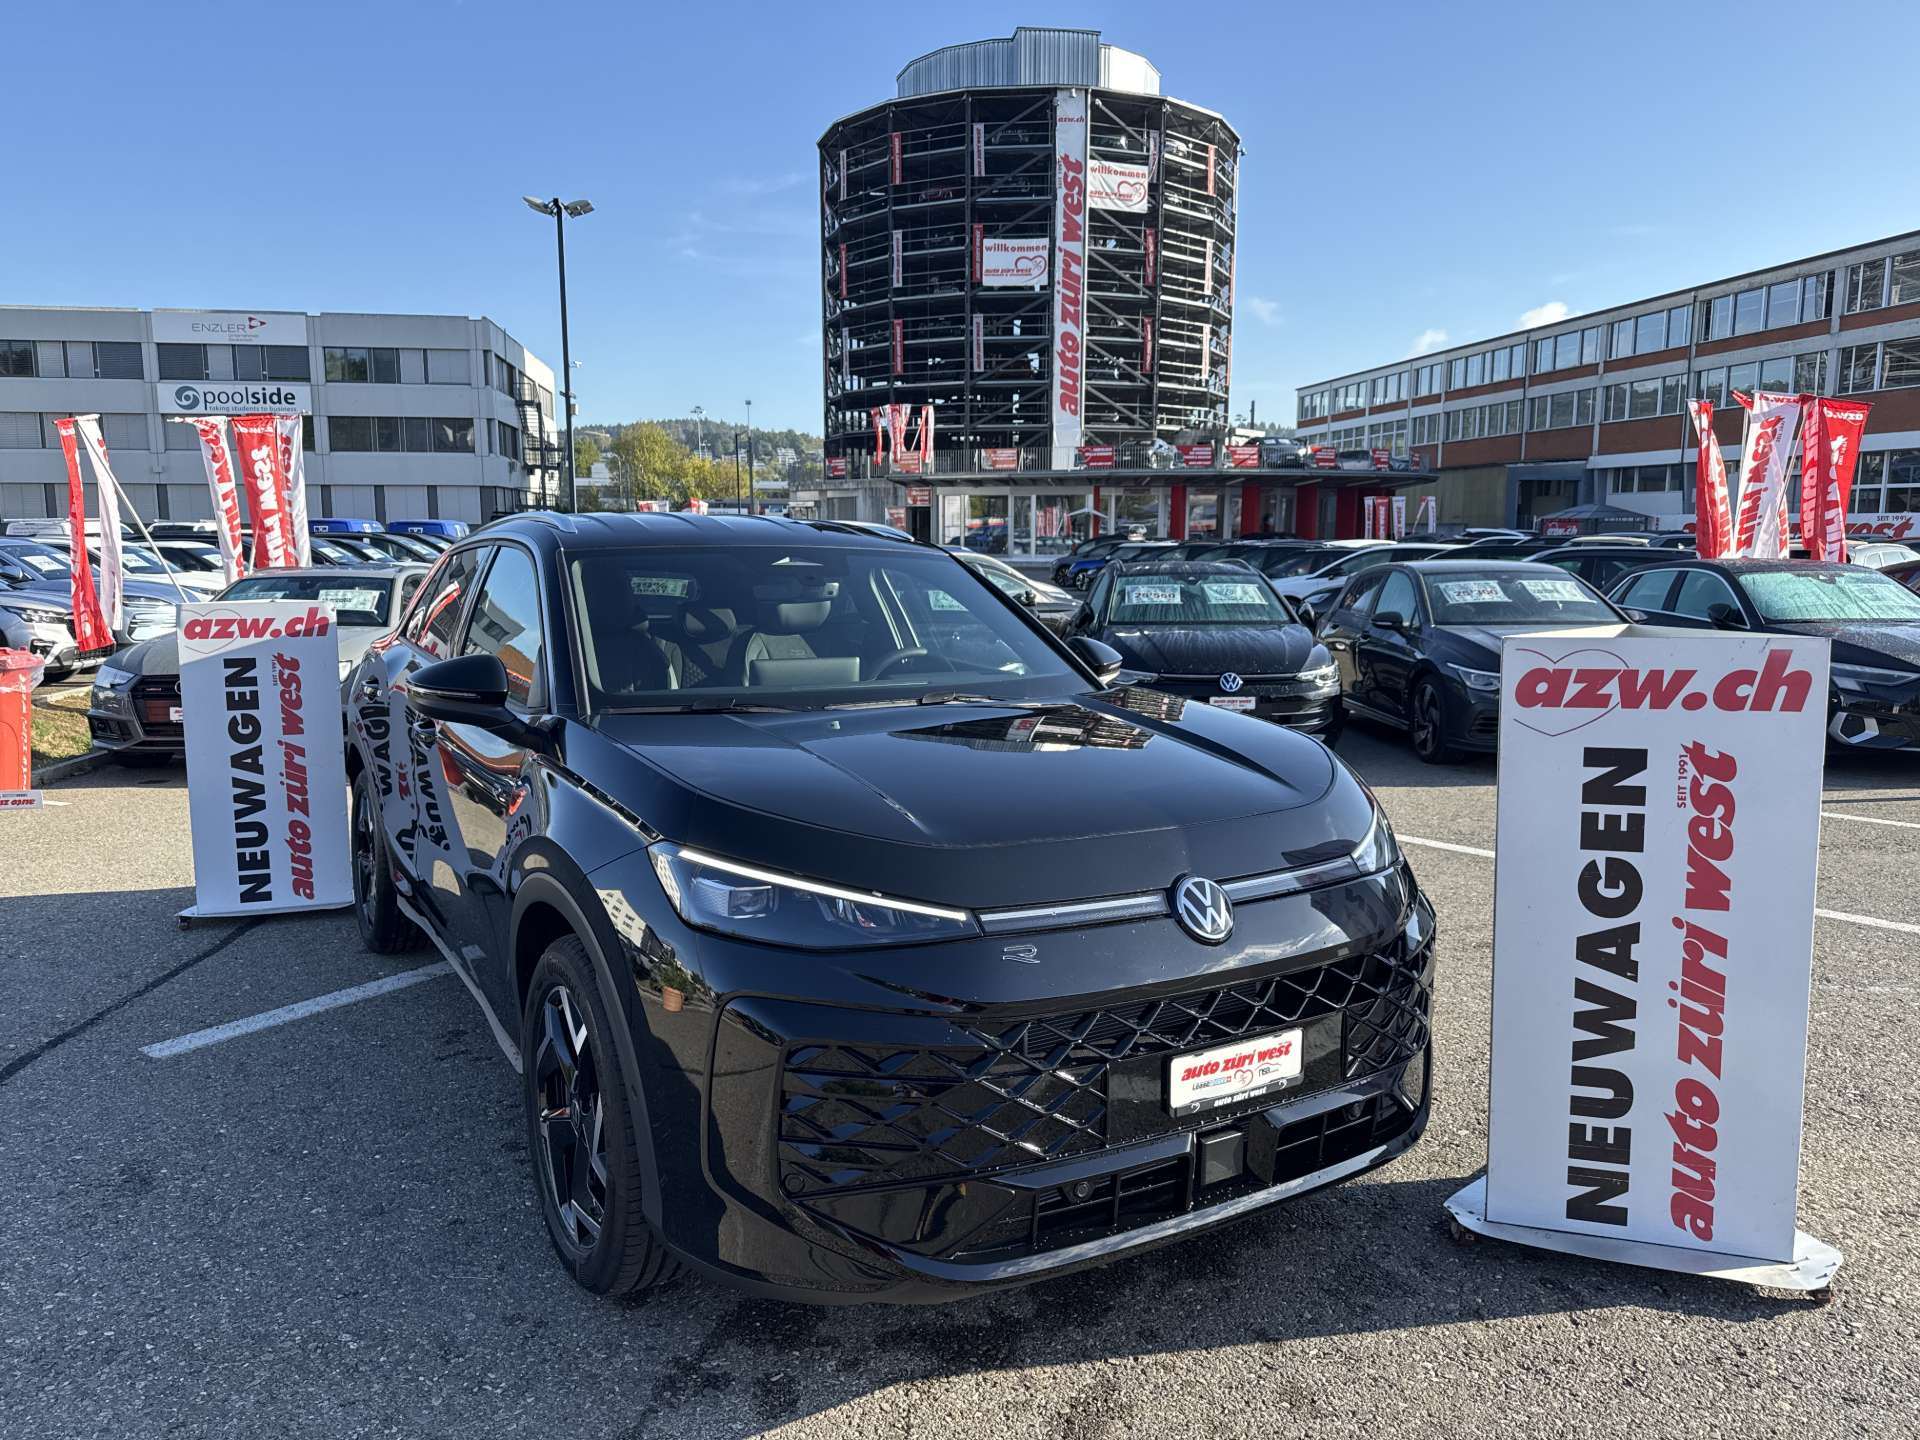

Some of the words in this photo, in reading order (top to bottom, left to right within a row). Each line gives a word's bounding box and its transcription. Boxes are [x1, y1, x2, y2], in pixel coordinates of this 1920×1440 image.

[1060, 153, 1083, 242] west
[1090, 164, 1146, 179] willkommen
[984, 243, 1046, 252] willkommen
[192, 322, 246, 333] ENZLER
[1056, 246, 1082, 330] züri
[203, 387, 296, 410] poolside
[1056, 331, 1080, 416] auto
[184, 607, 330, 640] azw.ch
[277, 652, 304, 736] west
[1514, 649, 1813, 713] azw.ch
[223, 658, 272, 904] NEUWAGEN
[277, 740, 310, 818] züri
[1677, 784, 1687, 808] SEIT
[1678, 754, 1688, 780] 1991
[284, 818, 314, 900] auto
[1680, 741, 1738, 913] west
[1566, 746, 1649, 1227] NEUWAGEN
[1667, 916, 1729, 1081] züri
[1181, 1060, 1220, 1082] auto
[1220, 1049, 1256, 1072] züri
[1258, 1040, 1292, 1064] west
[1664, 1077, 1721, 1242] auto
